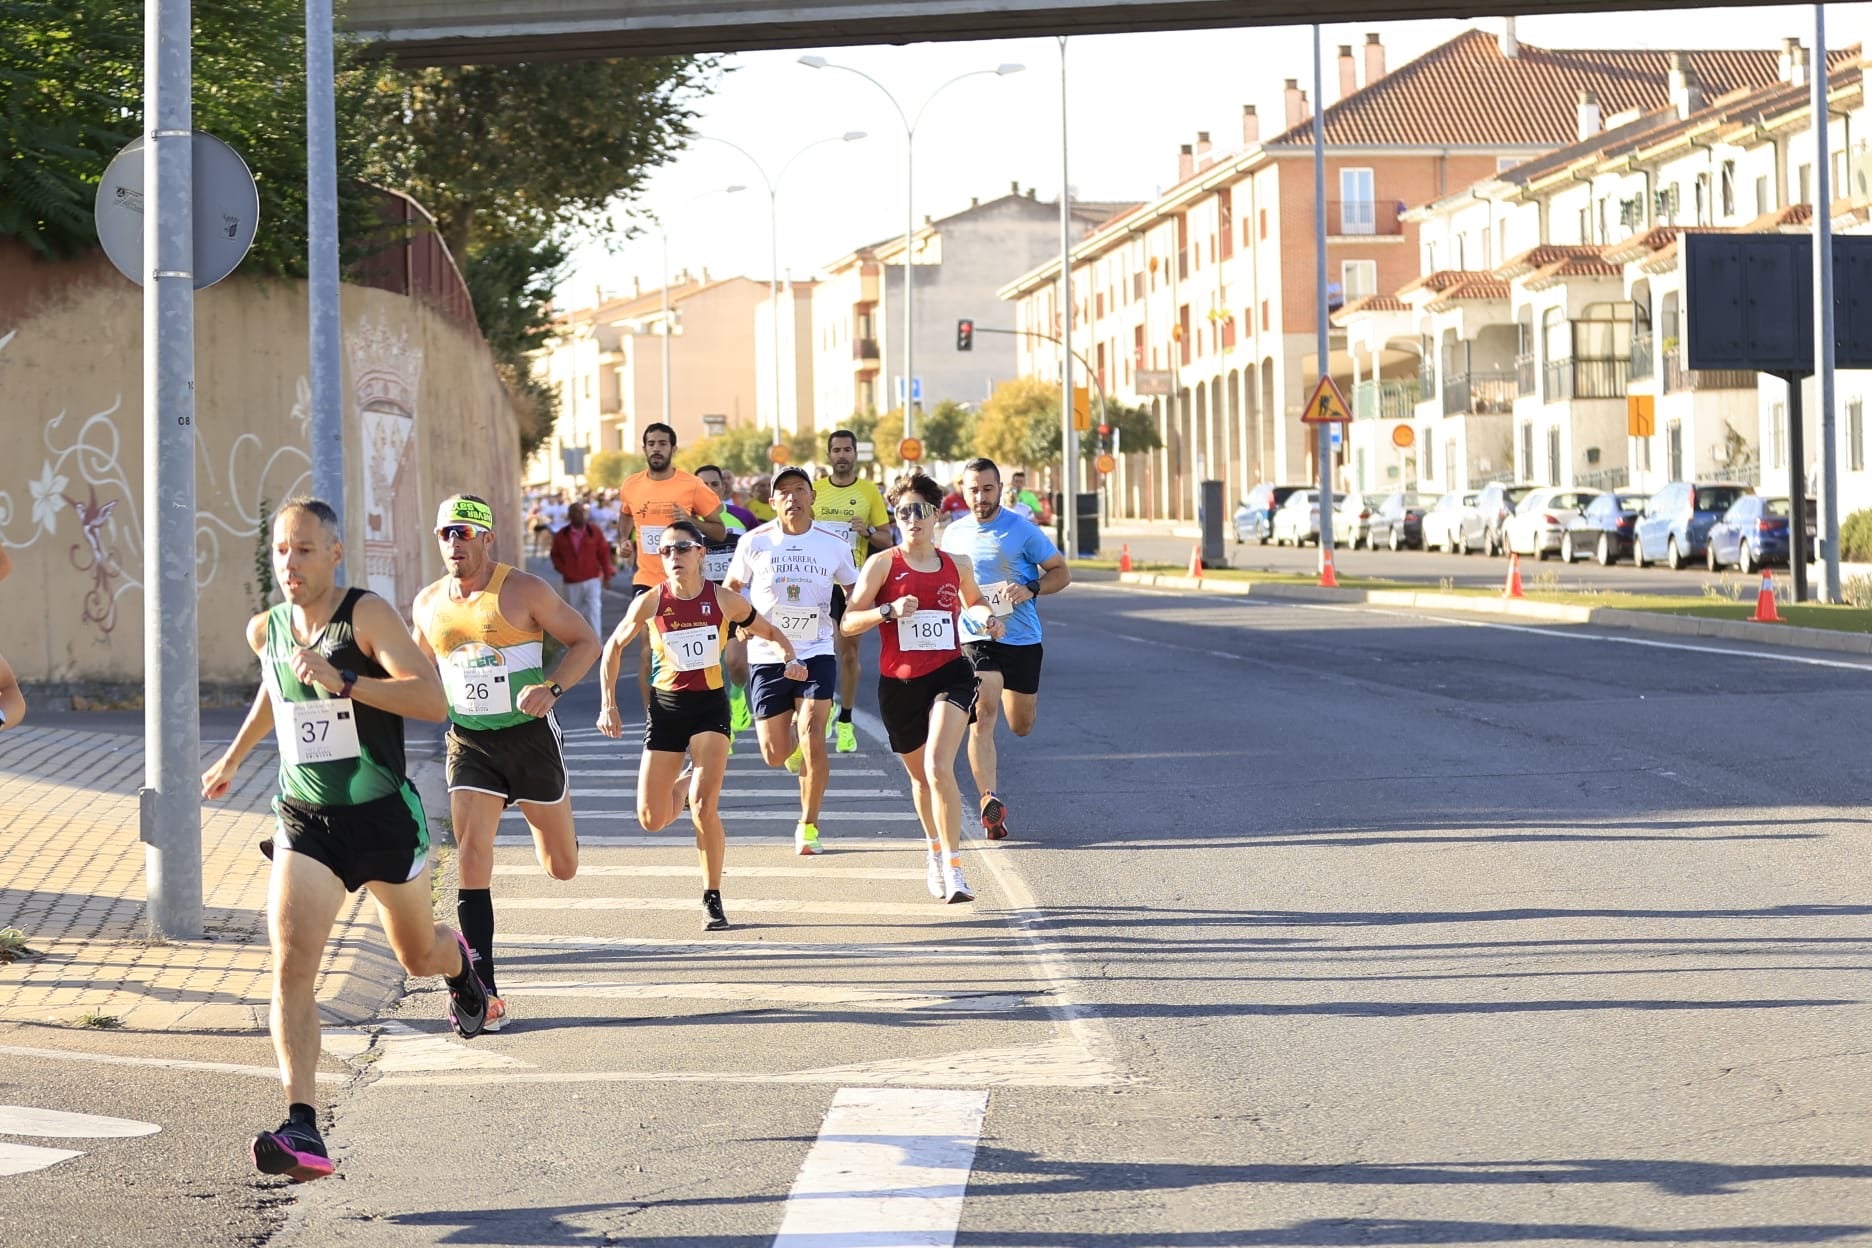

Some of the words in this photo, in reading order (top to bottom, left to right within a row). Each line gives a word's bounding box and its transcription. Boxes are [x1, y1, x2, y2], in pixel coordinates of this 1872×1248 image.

[178, 416, 191, 426] 08
[782, 555, 817, 565] CARRERA
[707, 563, 728, 573] 136
[804, 564, 828, 577] CIVIL
[781, 616, 810, 630] 377
[911, 622, 943, 638] 180
[682, 641, 704, 658] 10
[465, 683, 489, 700] 26
[301, 720, 330, 743] 37
